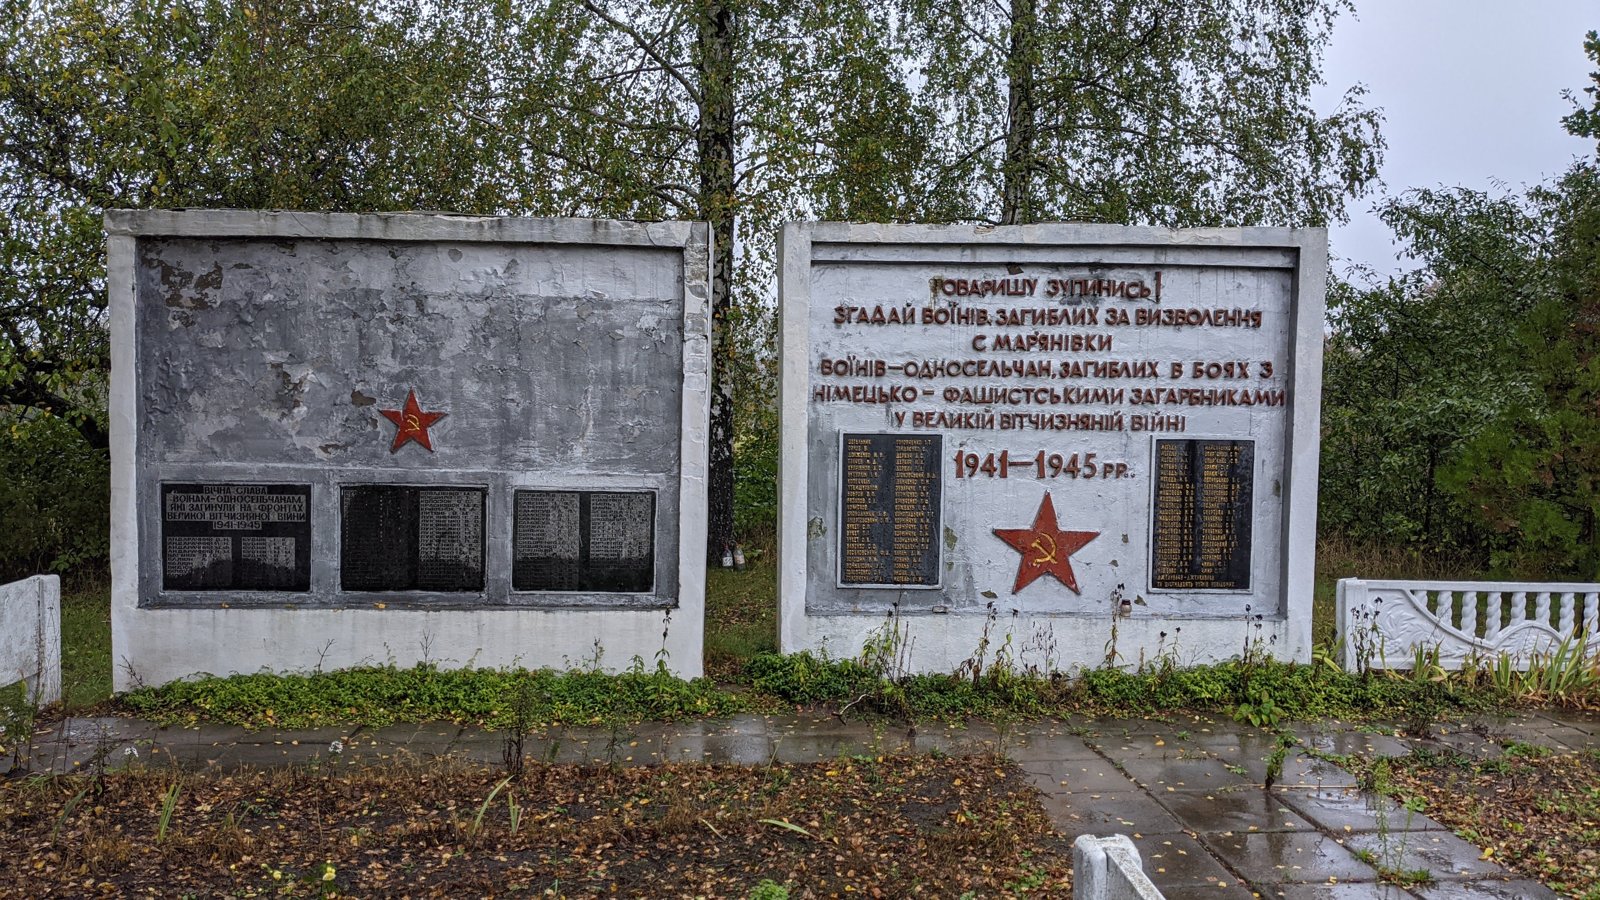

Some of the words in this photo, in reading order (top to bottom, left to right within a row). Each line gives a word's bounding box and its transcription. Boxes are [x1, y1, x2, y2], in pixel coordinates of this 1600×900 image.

[833, 302, 916, 325] ЗГАДАЙ
[995, 307, 1099, 326] ЗАГИБЛИХ
[1104, 308, 1130, 326] ЗА
[1134, 308, 1263, 328] ВИЗВОЛЕННЯ
[1059, 361, 1159, 380] ЗАГИБЛИХ
[1170, 362, 1184, 379] В
[1192, 361, 1250, 380] БОЯХ
[1259, 361, 1274, 380] З
[942, 385, 1125, 406] ФАШИСТСЬКИМИ
[1128, 387, 1286, 407] ЗАГАРБНИКАМИ
[894, 411, 906, 428] У
[911, 407, 996, 429] ВЕЛИКІЙ
[999, 410, 1125, 432] ВІТЧИЗНЯНІЙ
[1130, 410, 1187, 432] ВІЙНІ
[204, 486, 232, 495] ВІЧНА
[236, 486, 267, 495] СЛАВА
[240, 503, 252, 512] НА
[257, 503, 304, 512] ФРОНТАХ
